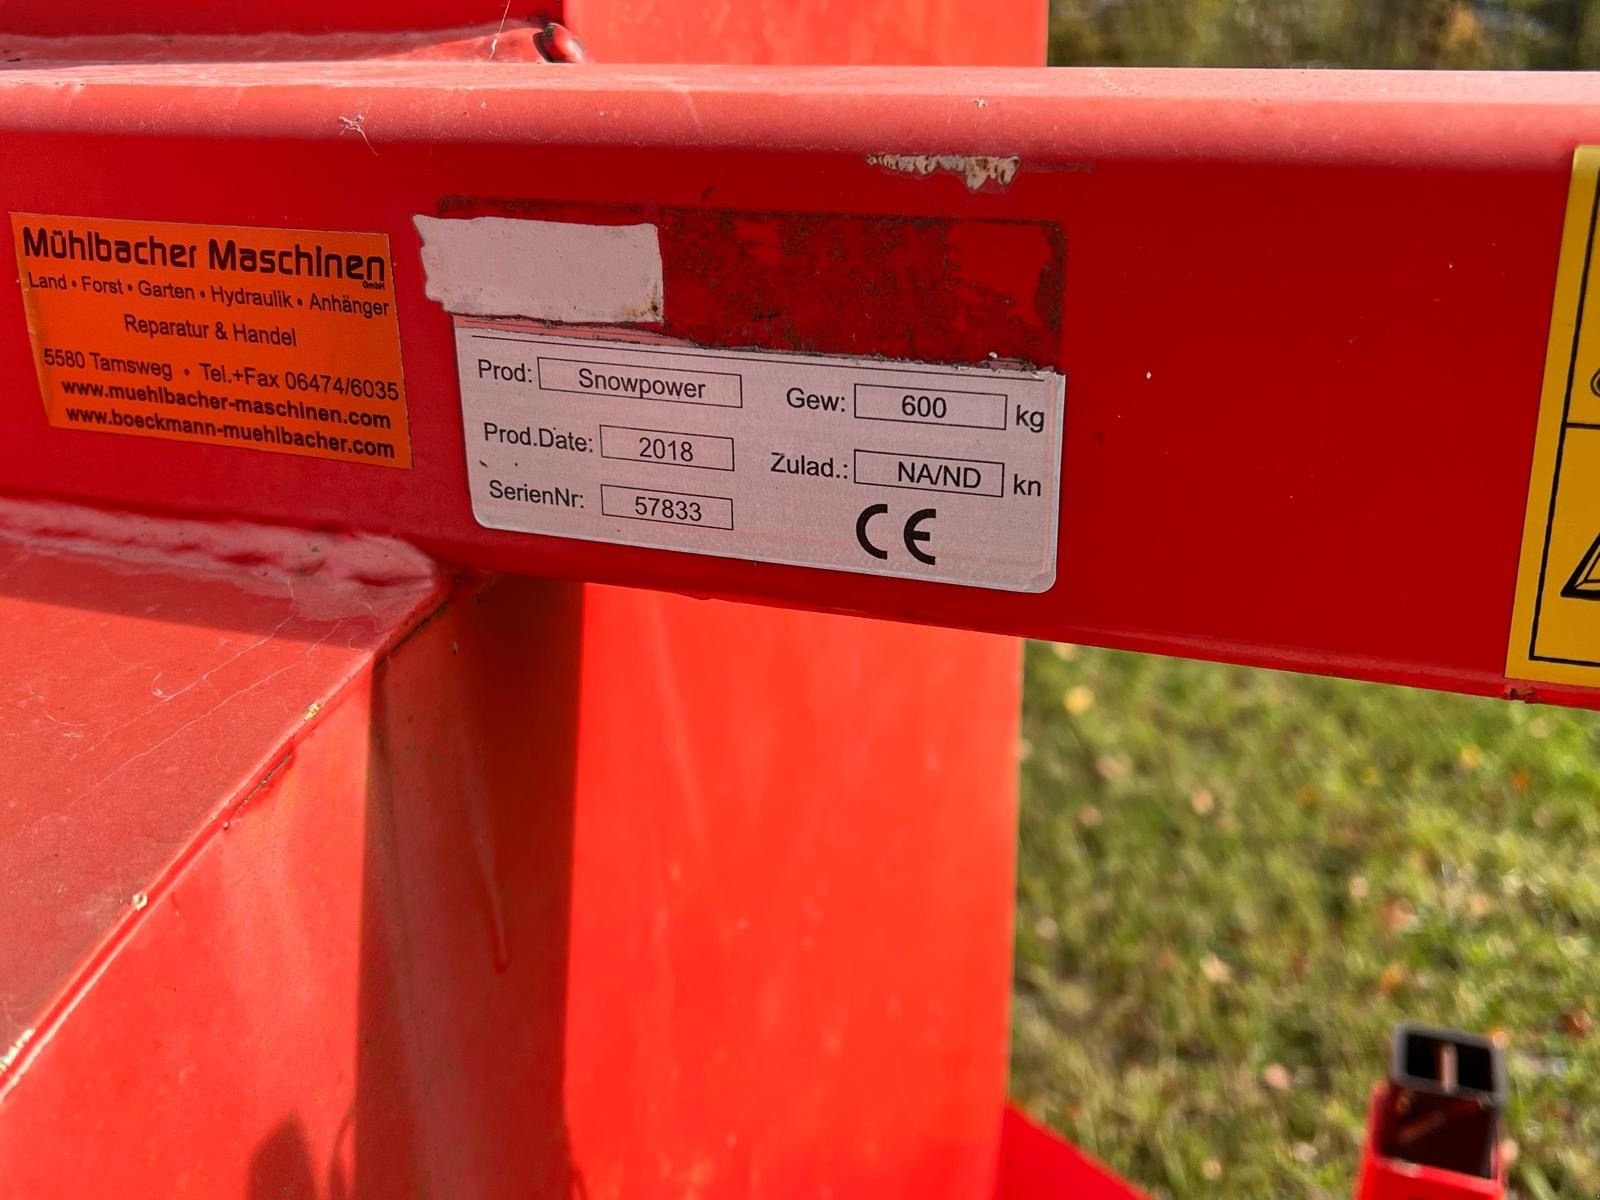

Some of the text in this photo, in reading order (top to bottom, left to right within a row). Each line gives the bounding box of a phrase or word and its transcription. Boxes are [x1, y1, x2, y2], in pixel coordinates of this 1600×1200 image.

[23, 227, 385, 280] Mühlbacher Maschinen
[29, 272, 389, 319] Land Forst Garten Hydraulik Anhänger
[363, 281, 385, 290] GmbH
[125, 314, 297, 346] Reparatur & Handel
[44, 348, 399, 401] 5580 Tamsweg Tel.+Fax 06474/6035
[478, 359, 706, 399] Prod: Snowpower
[61, 380, 391, 429] www.muehlbacher-maschinen.com
[786, 388, 1044, 432] Gew: 600 kg
[66, 405, 394, 458] www.boeckmann-muehlbacher.com
[484, 422, 694, 462] Prod.Date: 2018
[771, 452, 1041, 497] Zulad.: NA/ND kn
[489, 480, 702, 521] SerienNr: 57833
[856, 504, 936, 565] CE
